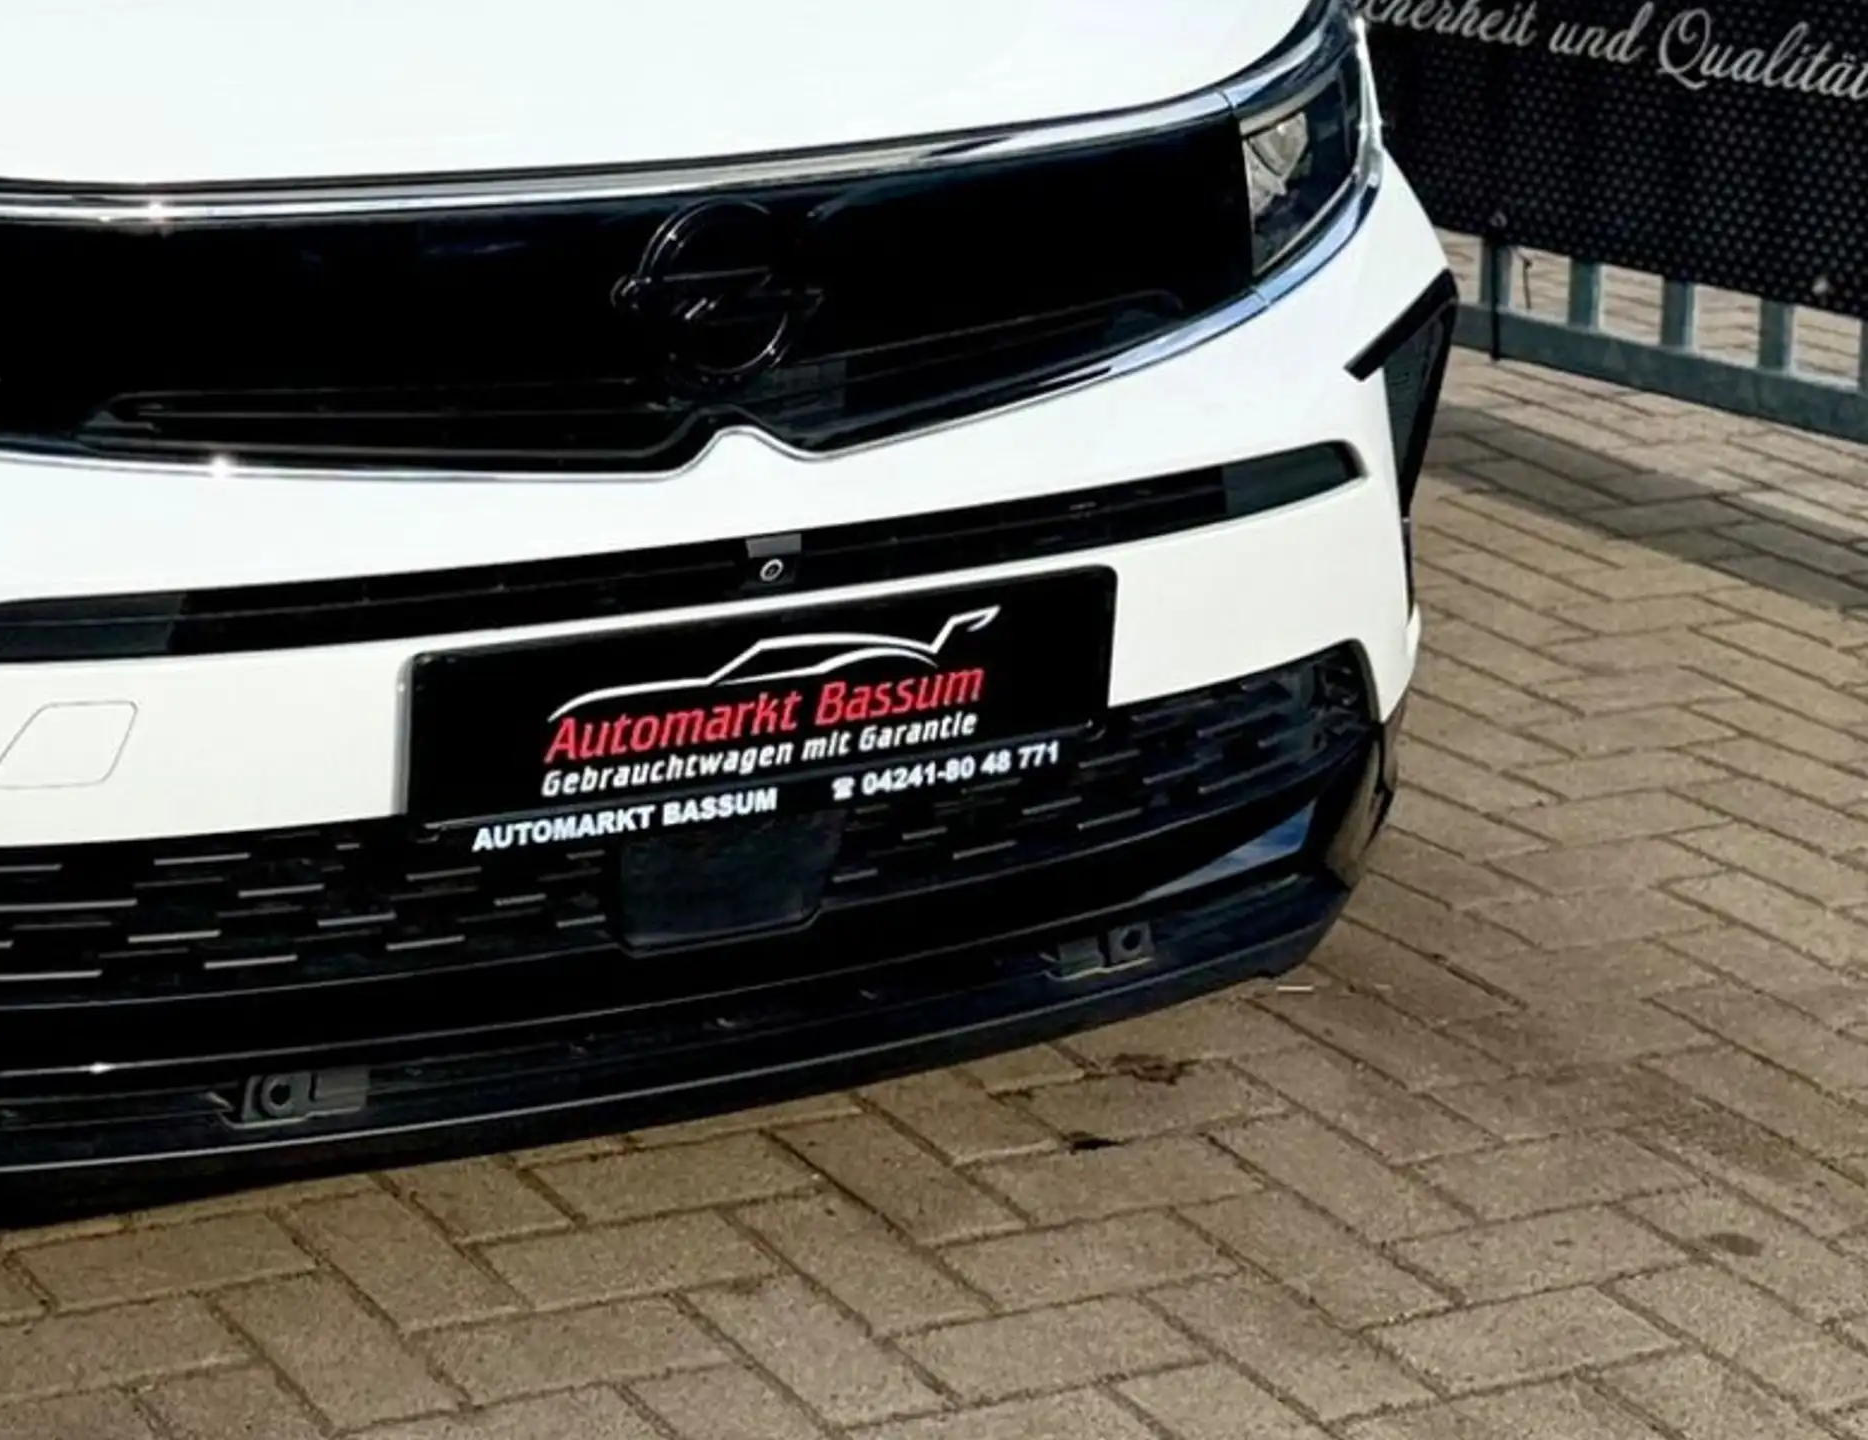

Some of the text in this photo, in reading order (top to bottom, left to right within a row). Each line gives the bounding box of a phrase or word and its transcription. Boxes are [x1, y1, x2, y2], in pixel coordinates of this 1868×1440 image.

[1549, 0, 1657, 64] und
[541, 711, 979, 797] Gebrauchtwagen mit Garantie
[543, 667, 984, 764] Automarkt Bassum
[472, 740, 1060, 852] AUTOMARKT BASSUM 04241-80 48 771
